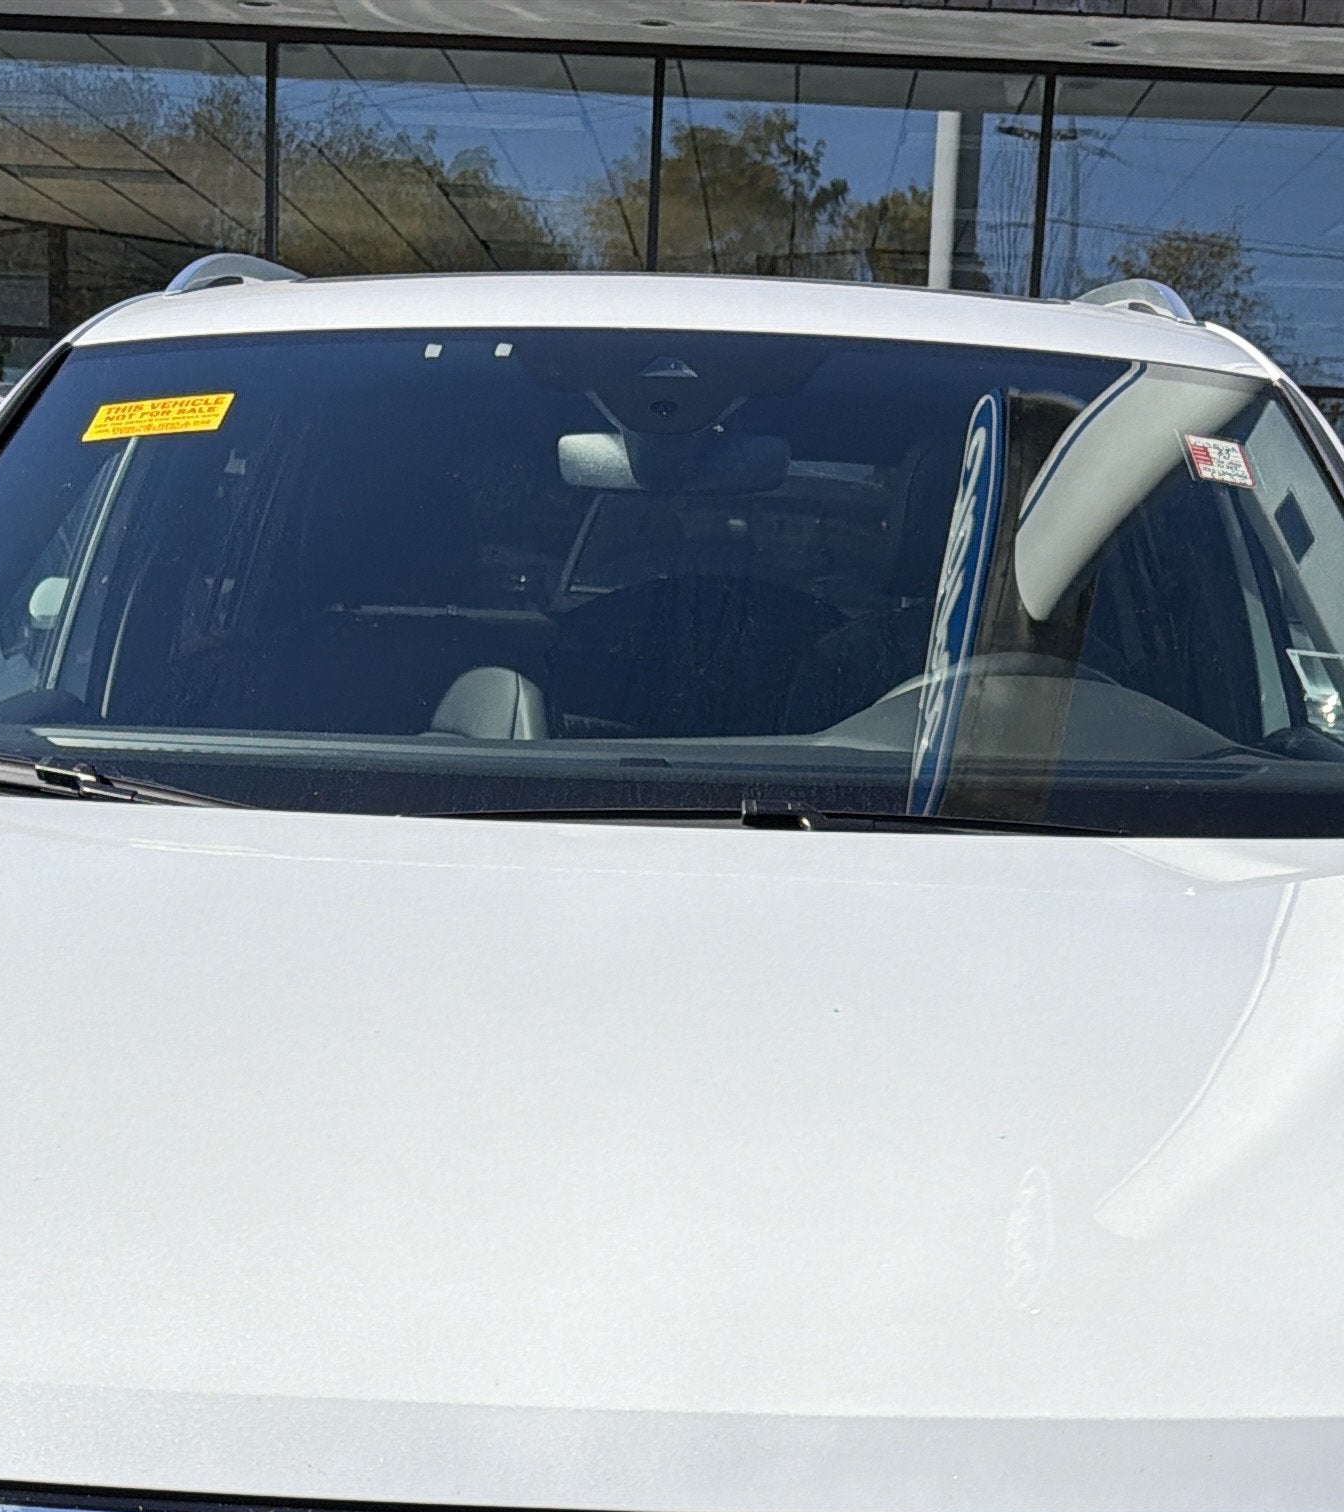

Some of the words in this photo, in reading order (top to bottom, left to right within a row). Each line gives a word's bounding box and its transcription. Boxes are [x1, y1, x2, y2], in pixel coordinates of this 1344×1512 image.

[104, 410, 138, 422] NOT
[140, 409, 173, 418] FOR
[175, 406, 217, 414] SALE
[106, 404, 144, 415] THIS
[150, 396, 227, 410] VEHICLE
